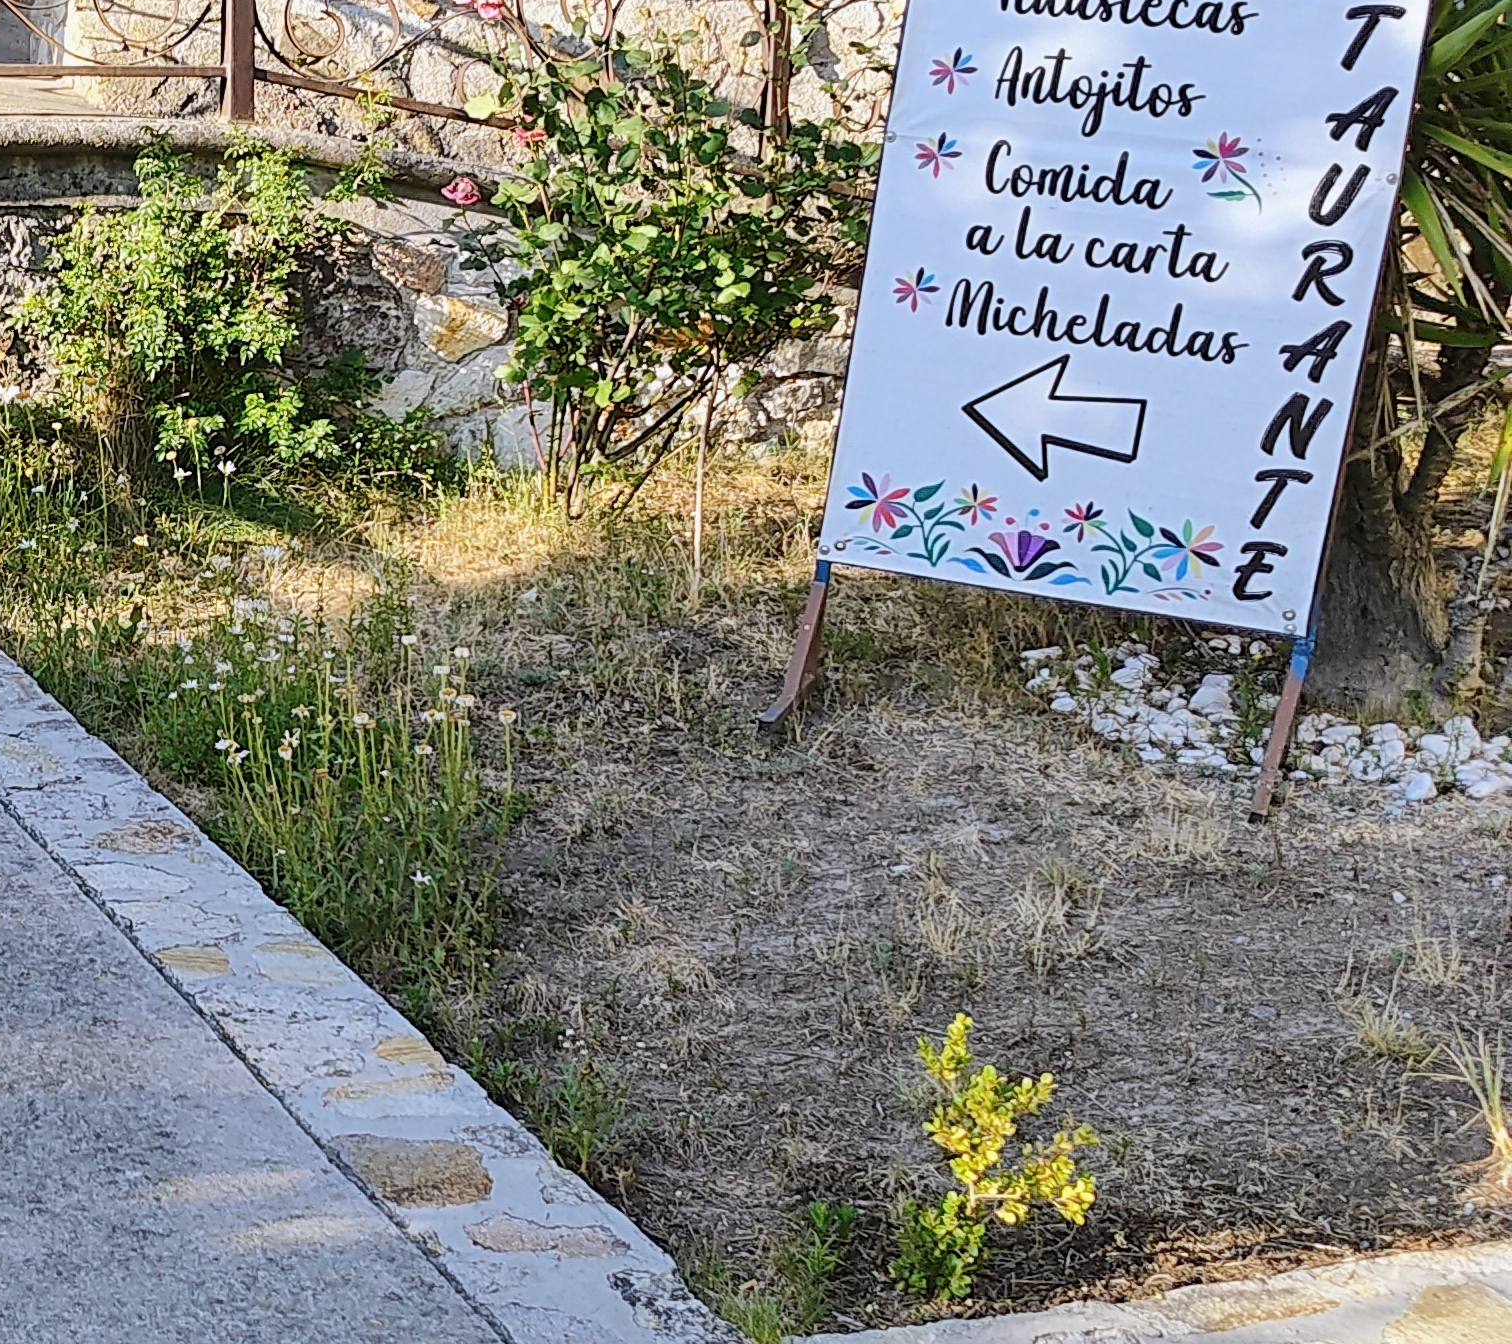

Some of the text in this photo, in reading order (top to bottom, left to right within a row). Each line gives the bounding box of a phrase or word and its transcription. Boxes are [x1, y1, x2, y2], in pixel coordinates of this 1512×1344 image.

[994, 45, 1207, 138] Antojitos
[984, 139, 1174, 211] Comida
[965, 205, 1230, 284] a la carta
[945, 277, 1251, 366] Micheladas
